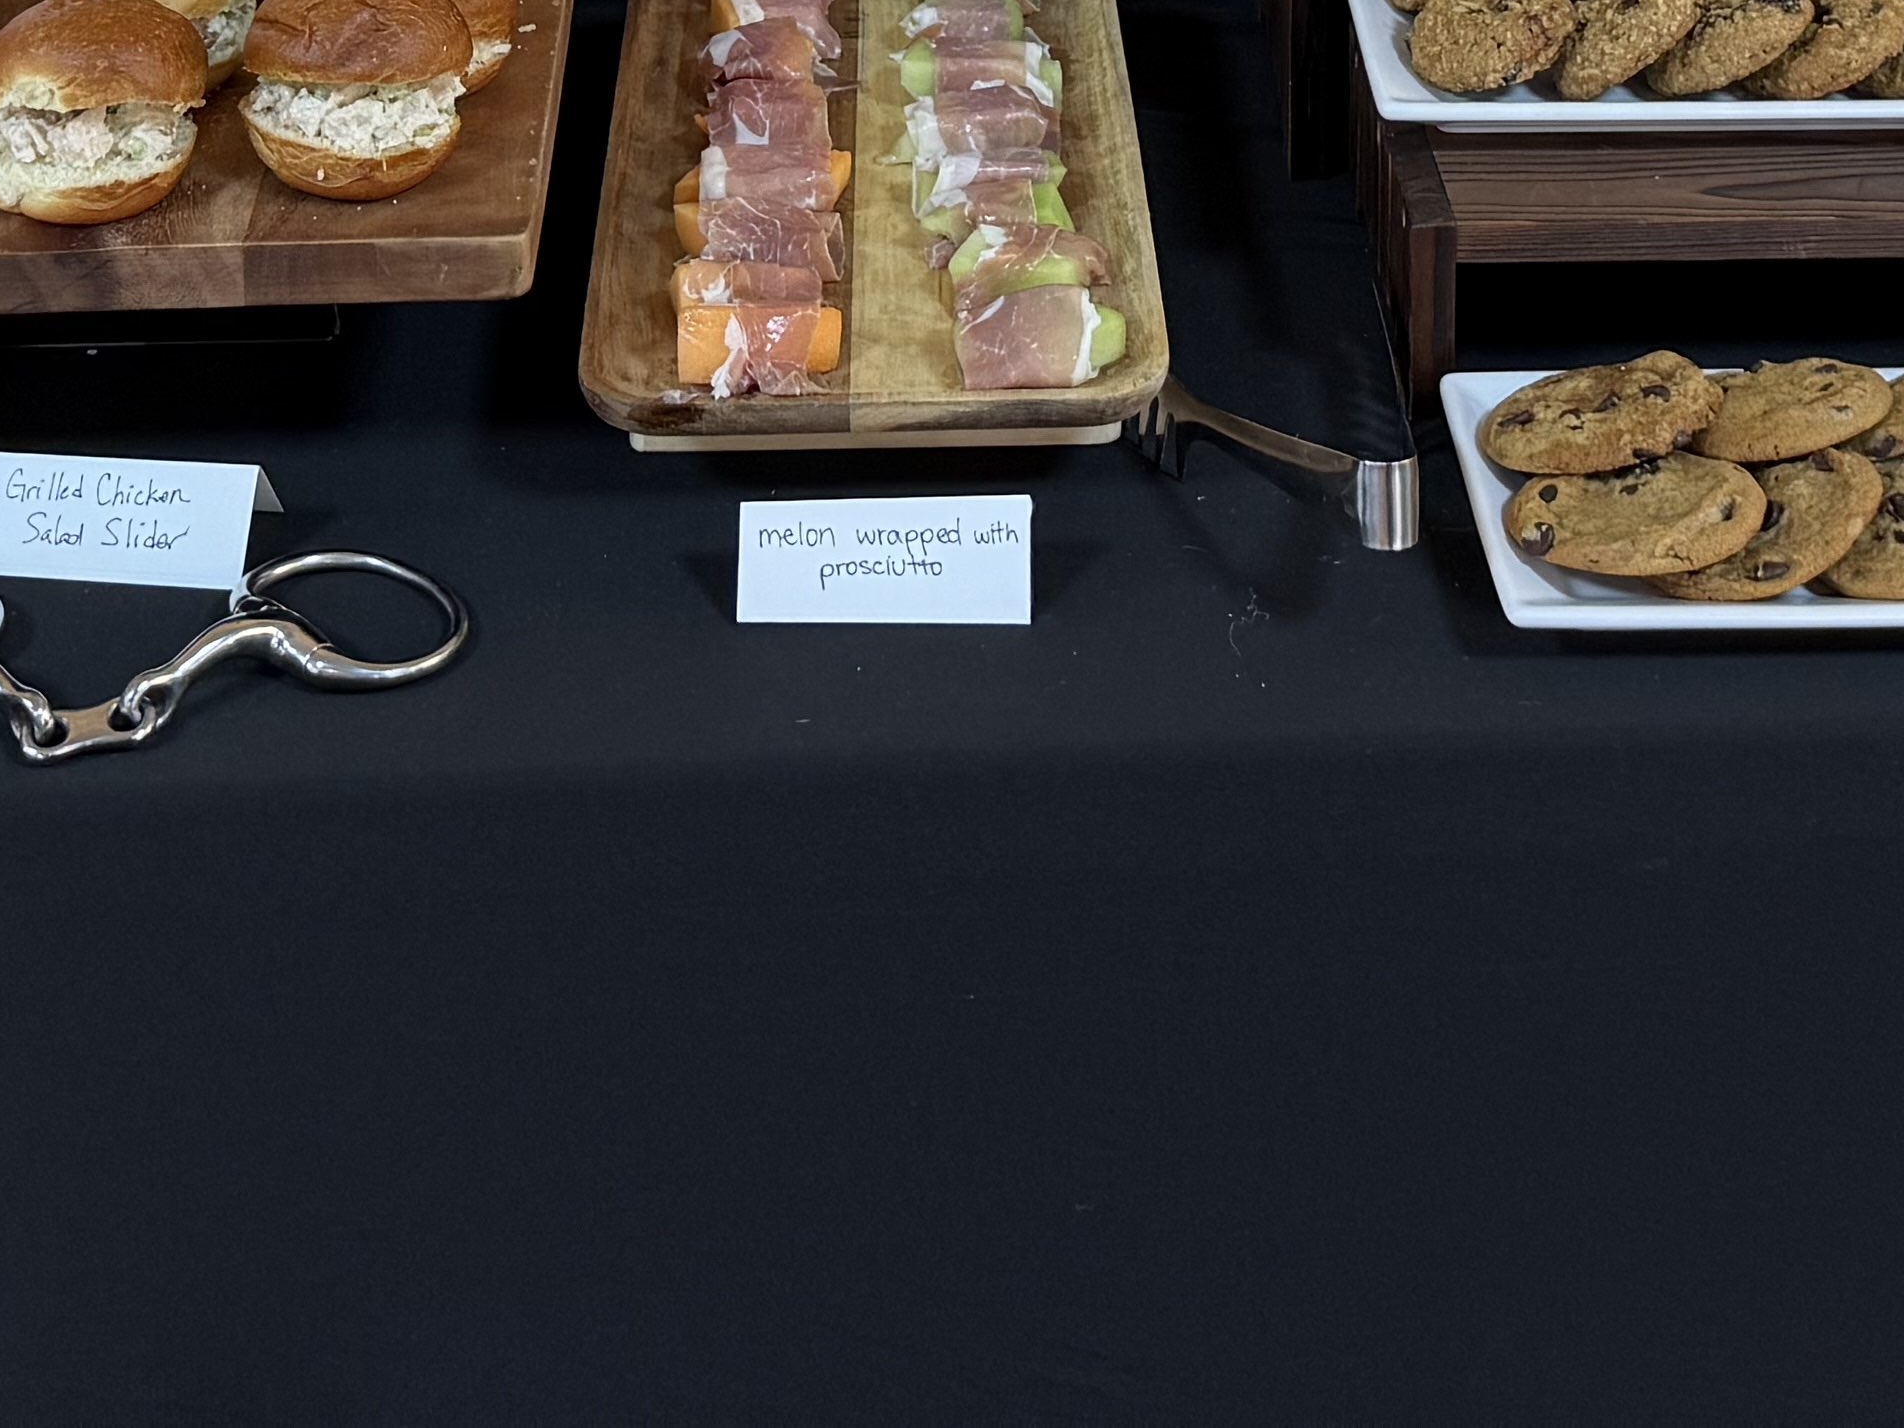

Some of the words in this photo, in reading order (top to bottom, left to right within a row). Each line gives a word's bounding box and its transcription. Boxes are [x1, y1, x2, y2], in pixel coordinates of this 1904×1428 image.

[5, 467, 84, 503] Grilled
[96, 472, 191, 507] Chicken
[100, 517, 191, 550] Slider
[758, 520, 836, 549] melon
[855, 516, 962, 557] wrapped
[973, 520, 1019, 545] with
[819, 554, 943, 591] prosciutto
